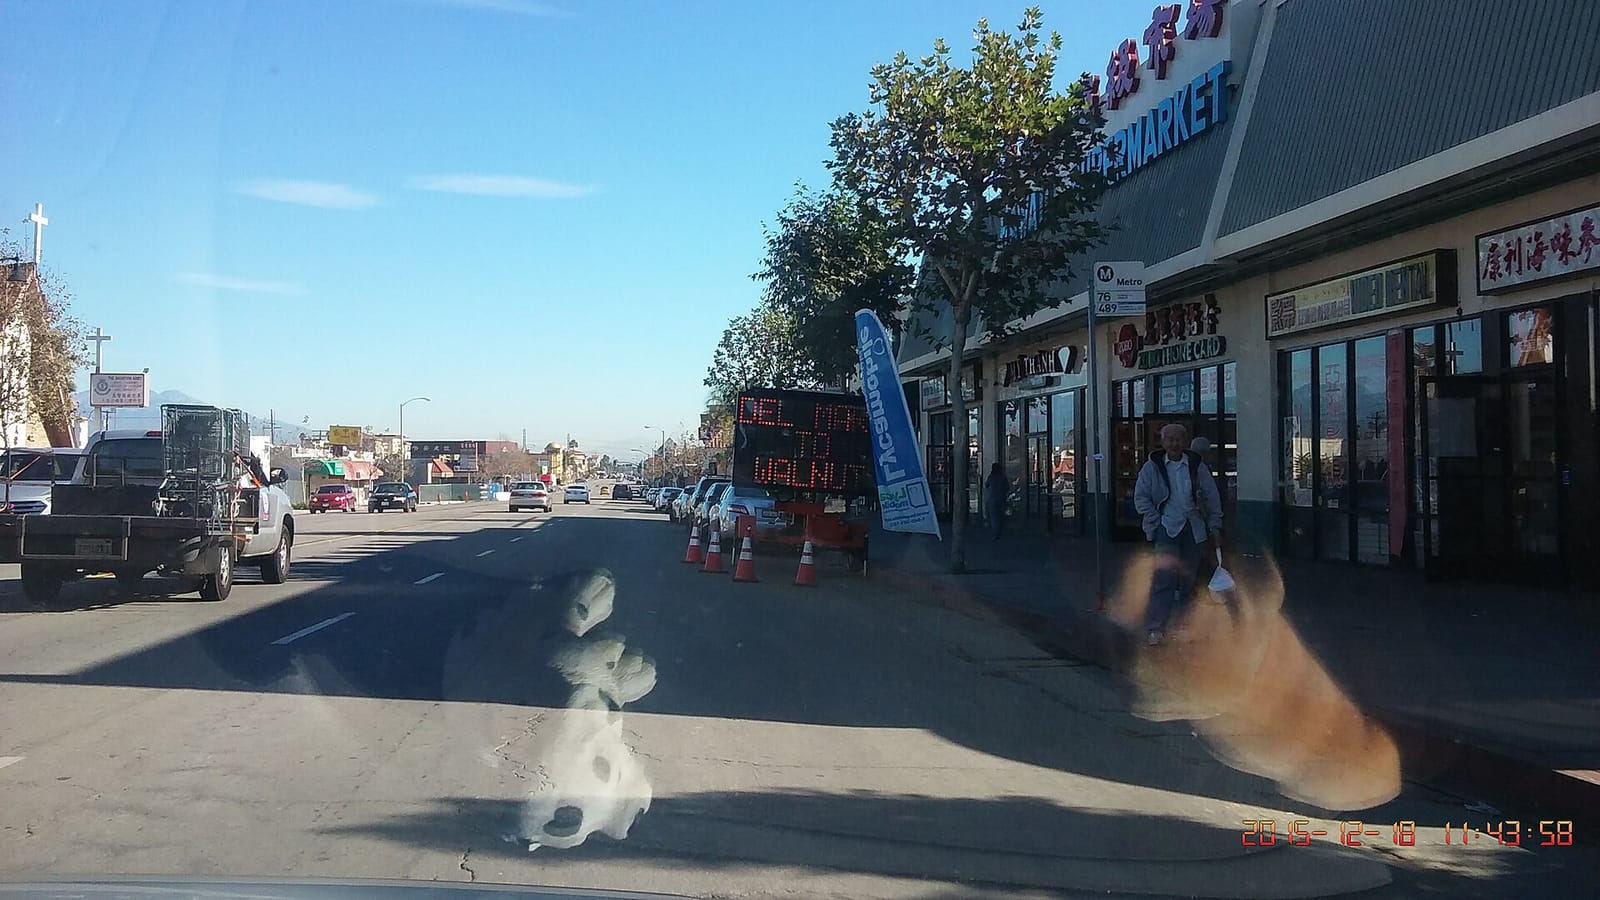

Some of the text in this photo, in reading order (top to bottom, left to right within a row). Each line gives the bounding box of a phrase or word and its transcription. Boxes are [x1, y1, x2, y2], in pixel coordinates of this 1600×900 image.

[1084, 0, 1228, 117] 級市場
[1116, 278, 1143, 286] Metro
[1097, 292, 1111, 302] 76
[1098, 303, 1117, 313] 489
[1193, 337, 1221, 360] CARD
[738, 395, 794, 428] DEL
[793, 430, 831, 460] TO
[752, 455, 867, 490] WALNUT
